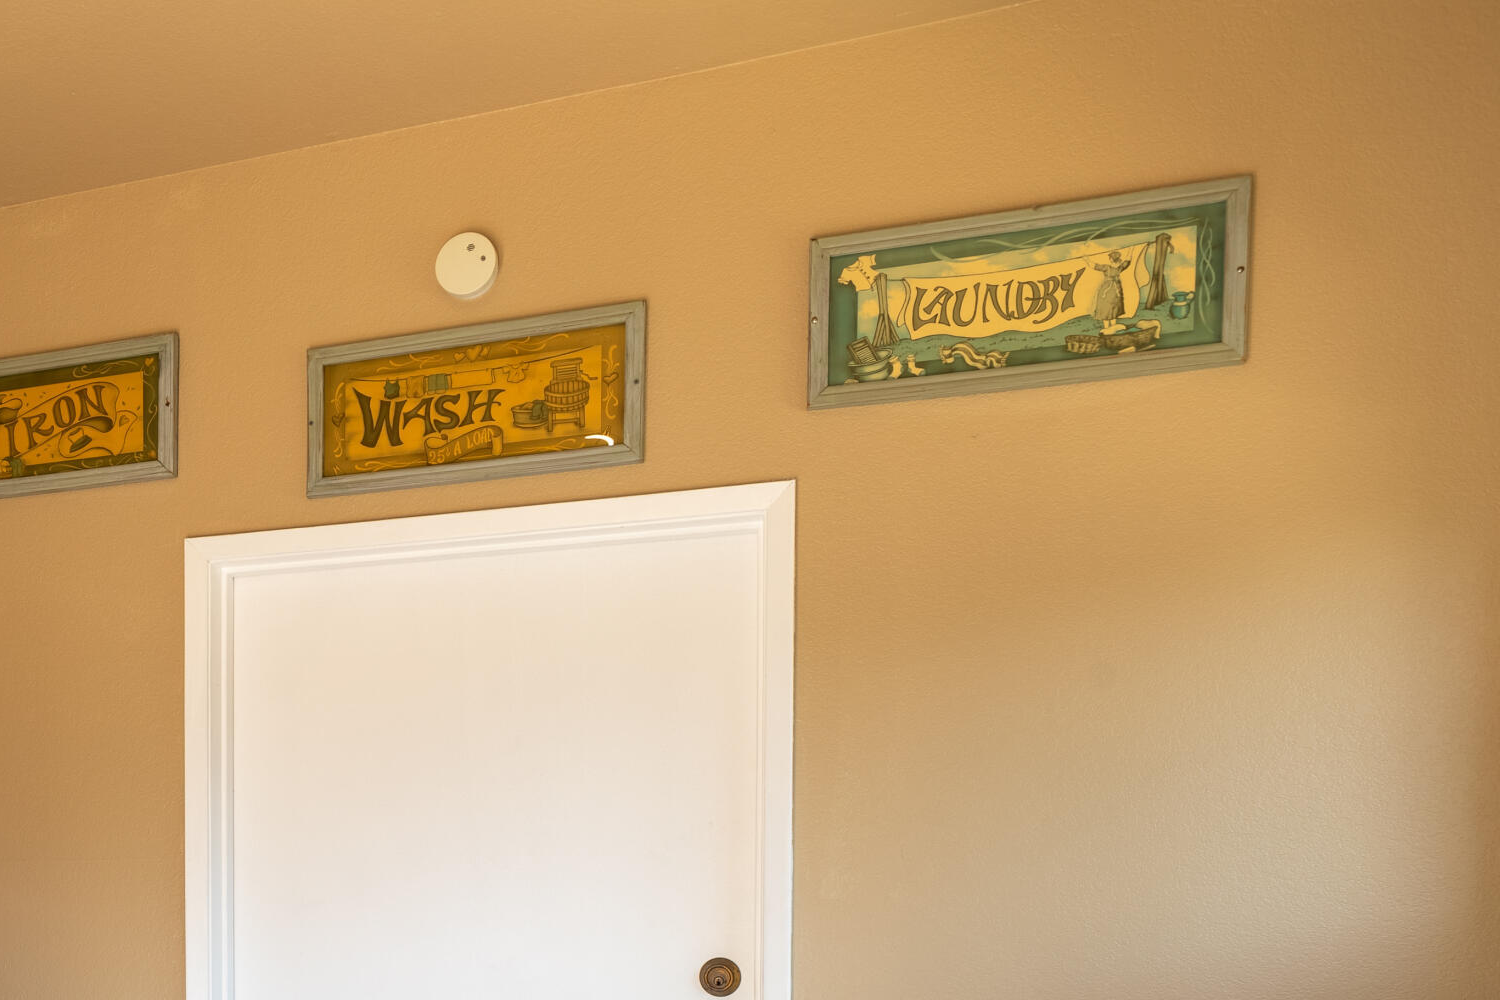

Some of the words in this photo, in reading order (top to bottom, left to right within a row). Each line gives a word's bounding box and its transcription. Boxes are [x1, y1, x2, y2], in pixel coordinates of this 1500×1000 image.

[911, 267, 1085, 331] LAUNDRY
[4, 384, 108, 457] IRON
[352, 388, 505, 448] WASH
[453, 440, 462, 457] A
[466, 427, 494, 449] LOAD
